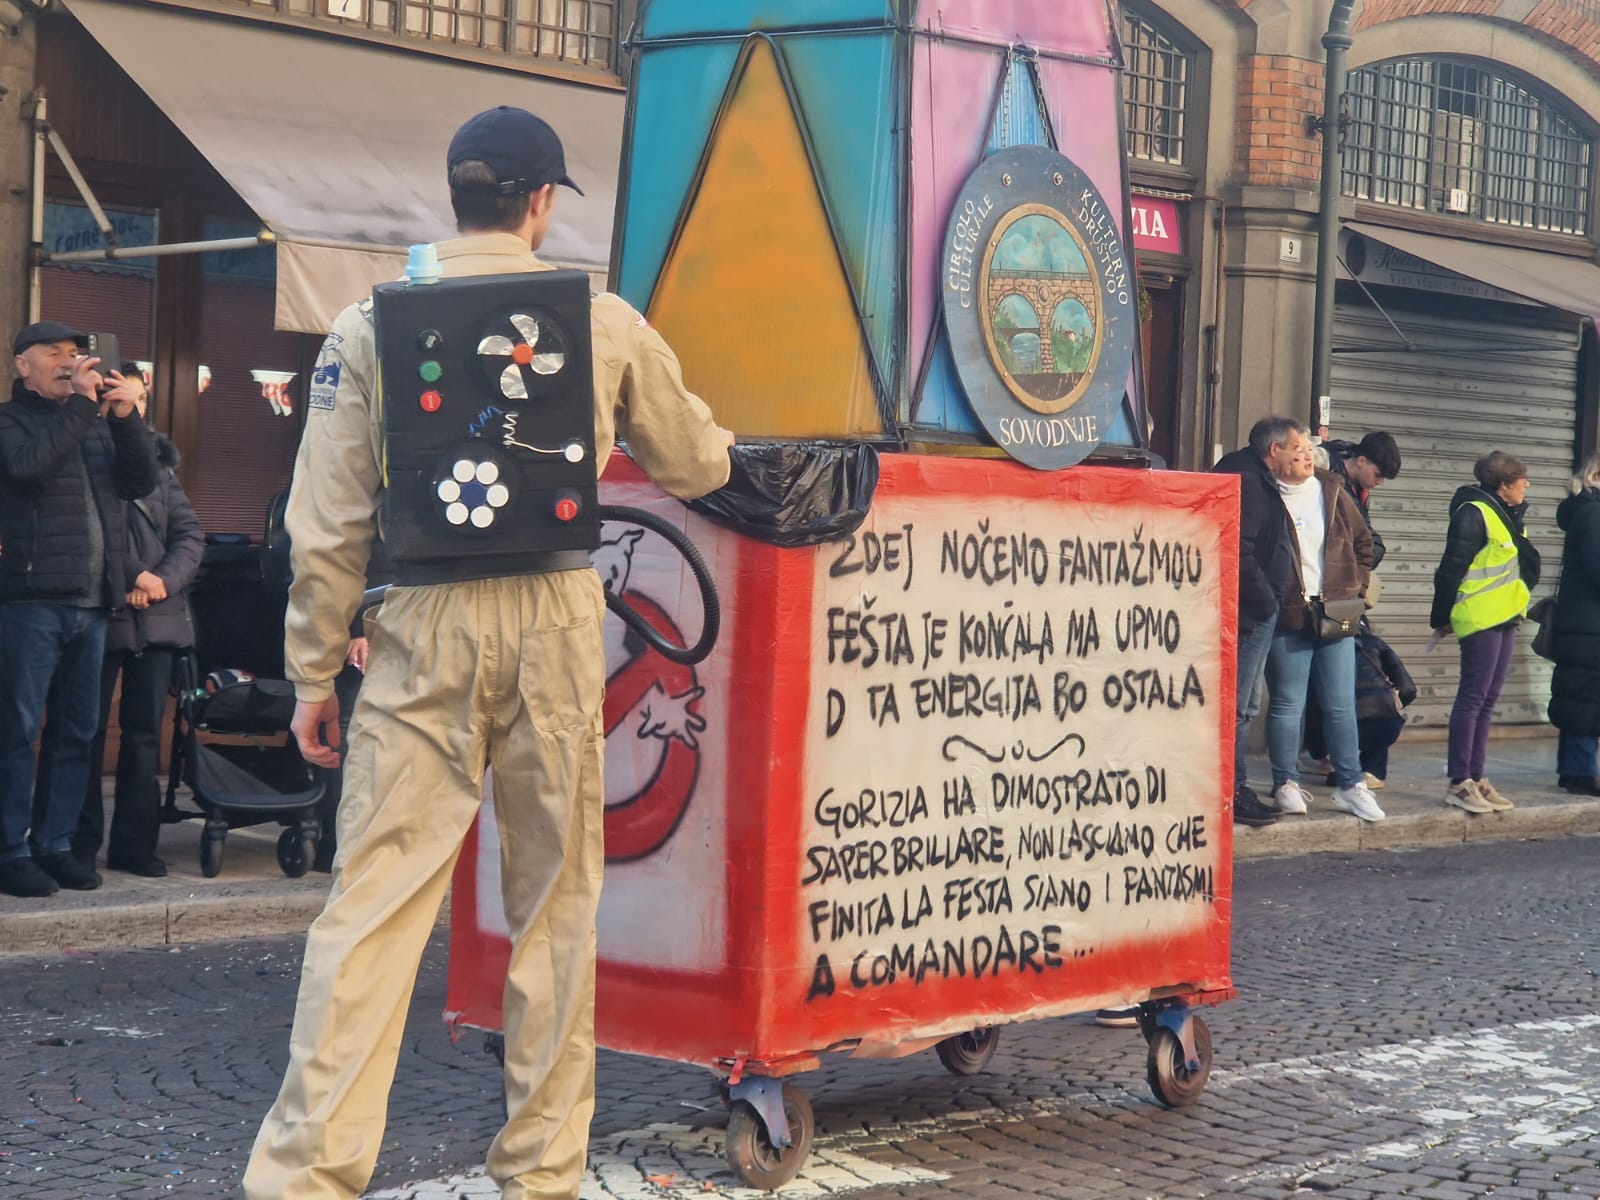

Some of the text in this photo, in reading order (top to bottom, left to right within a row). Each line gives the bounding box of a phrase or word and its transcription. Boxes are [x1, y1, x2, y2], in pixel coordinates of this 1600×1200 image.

[949, 200, 974, 290] CIRCOLO
[960, 194, 994, 308] CULTURALE
[1081, 188, 1129, 304] KULTURNO
[1288, 240, 1294, 255] 9
[999, 415, 1099, 448] SOVODNJE
[941, 518, 1049, 586] NOČEMO
[1059, 524, 1201, 589] FANTAŽMOU
[828, 594, 914, 667] FEŠTA
[923, 611, 947, 669] JE
[1067, 607, 1099, 657] MA
[1116, 604, 1180, 653] UPMO
[827, 665, 1204, 738] D TA ENERGIJA BO OSTALA
[815, 765, 1166, 837] GORIZIA HA DIMOSTRATO DI
[803, 816, 1207, 885] SAPER BRILLARE, NON LASCIAMO CHE
[809, 862, 1213, 942] FINITA LA FESTA SIANO I FANTASMI
[806, 953, 835, 1002] A
